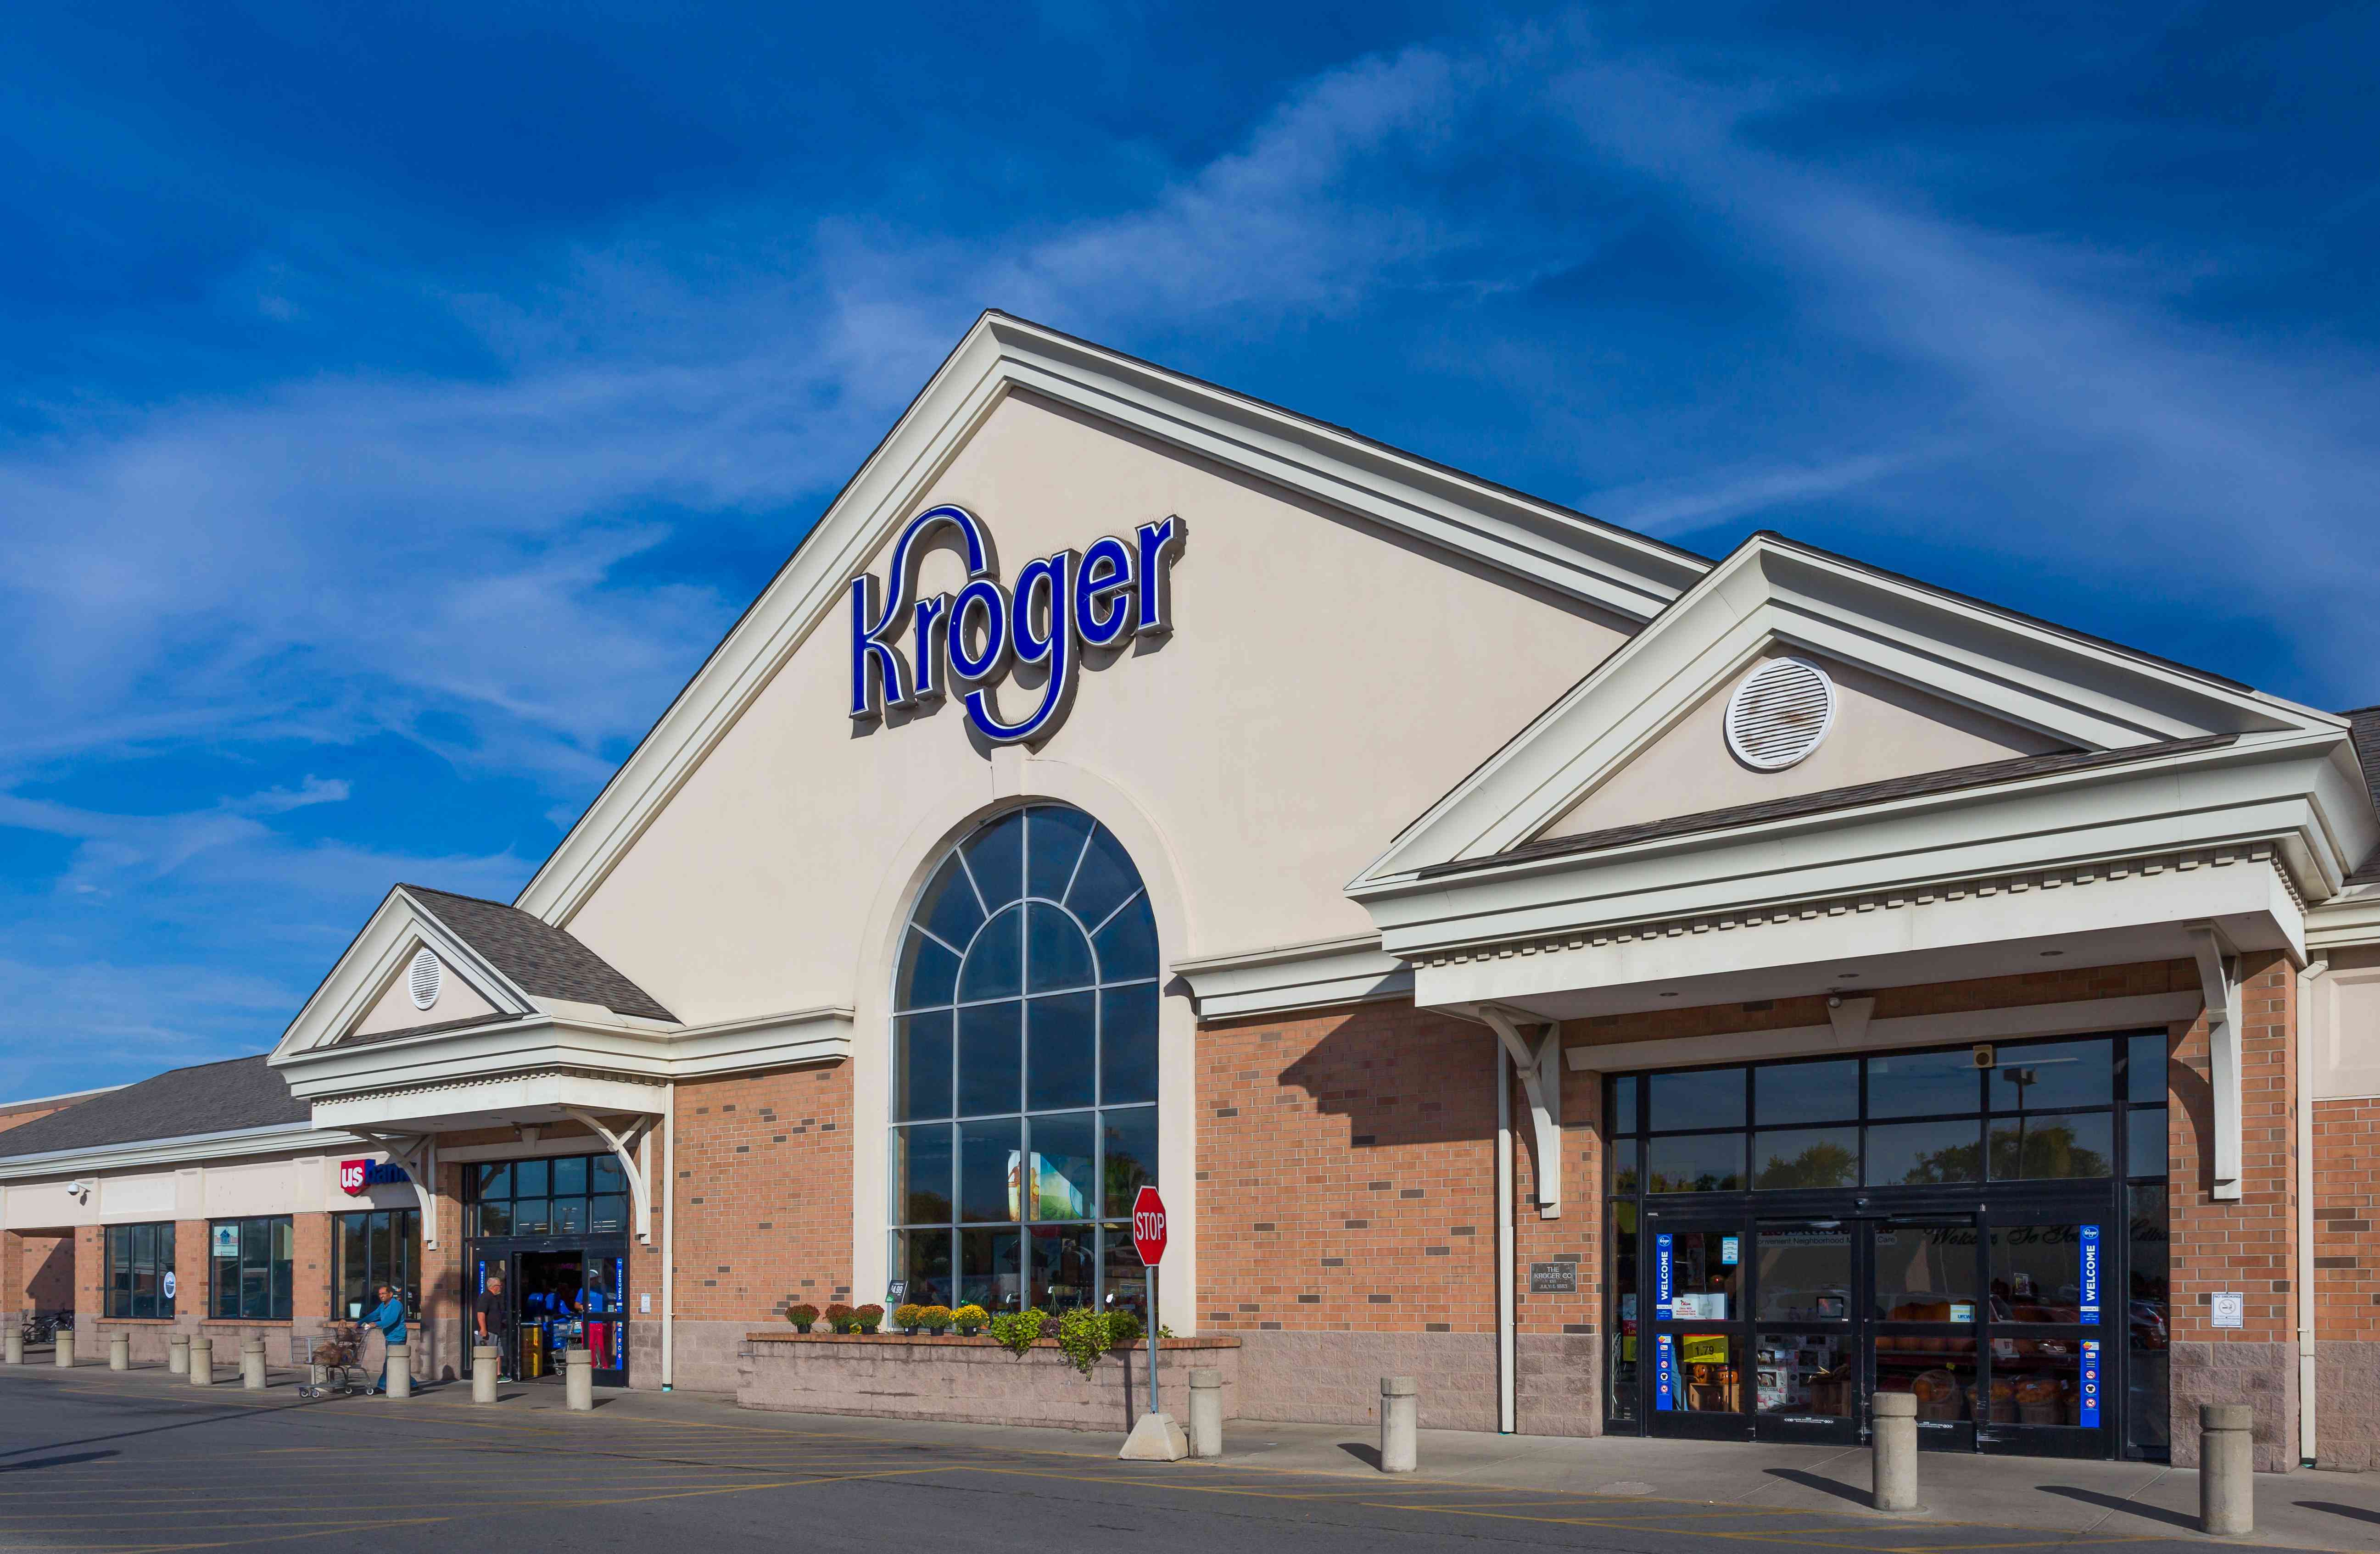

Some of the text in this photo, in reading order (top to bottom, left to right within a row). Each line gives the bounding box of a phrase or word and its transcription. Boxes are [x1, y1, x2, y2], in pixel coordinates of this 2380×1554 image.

[849, 503, 1175, 742] Kroger
[341, 1167, 363, 1187] us
[1136, 1212, 1164, 1241] STOP
[1793, 1237, 1844, 1245] Neighborhood
[2086, 1245, 2095, 1301] WELCOME
[891, 1285, 903, 1293] $4.99
[1695, 1346, 1714, 1355] 1.79
